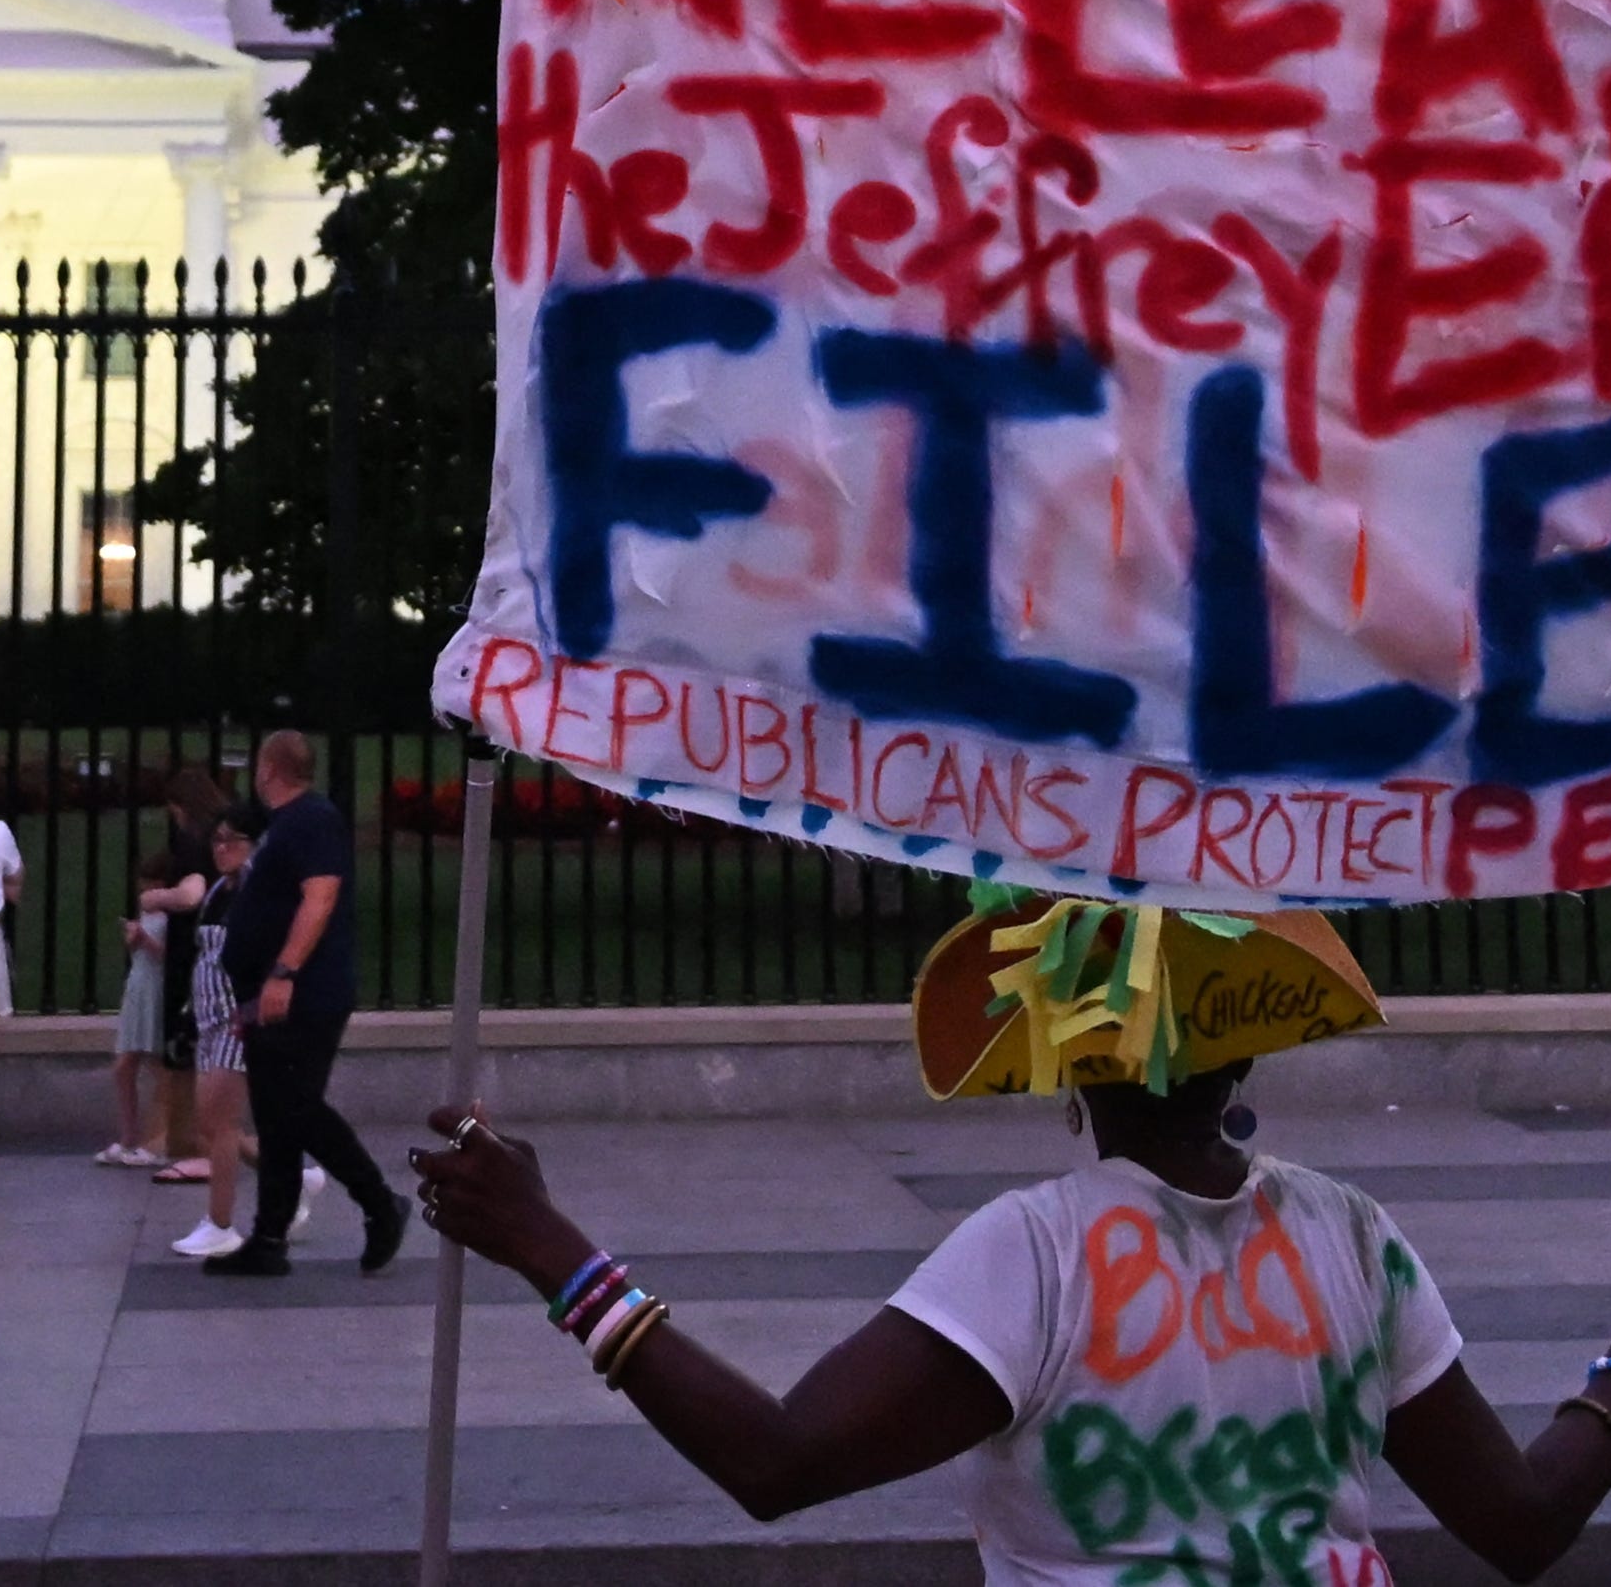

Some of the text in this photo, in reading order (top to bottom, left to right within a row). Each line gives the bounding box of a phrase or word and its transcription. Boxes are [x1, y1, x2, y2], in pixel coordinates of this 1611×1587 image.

[471, 637, 1090, 861] REPUBLICANS
[1110, 763, 1452, 891] PROTECT
[1191, 968, 1330, 1040] CHICKENS
[1083, 1183, 1331, 1385] Bad
